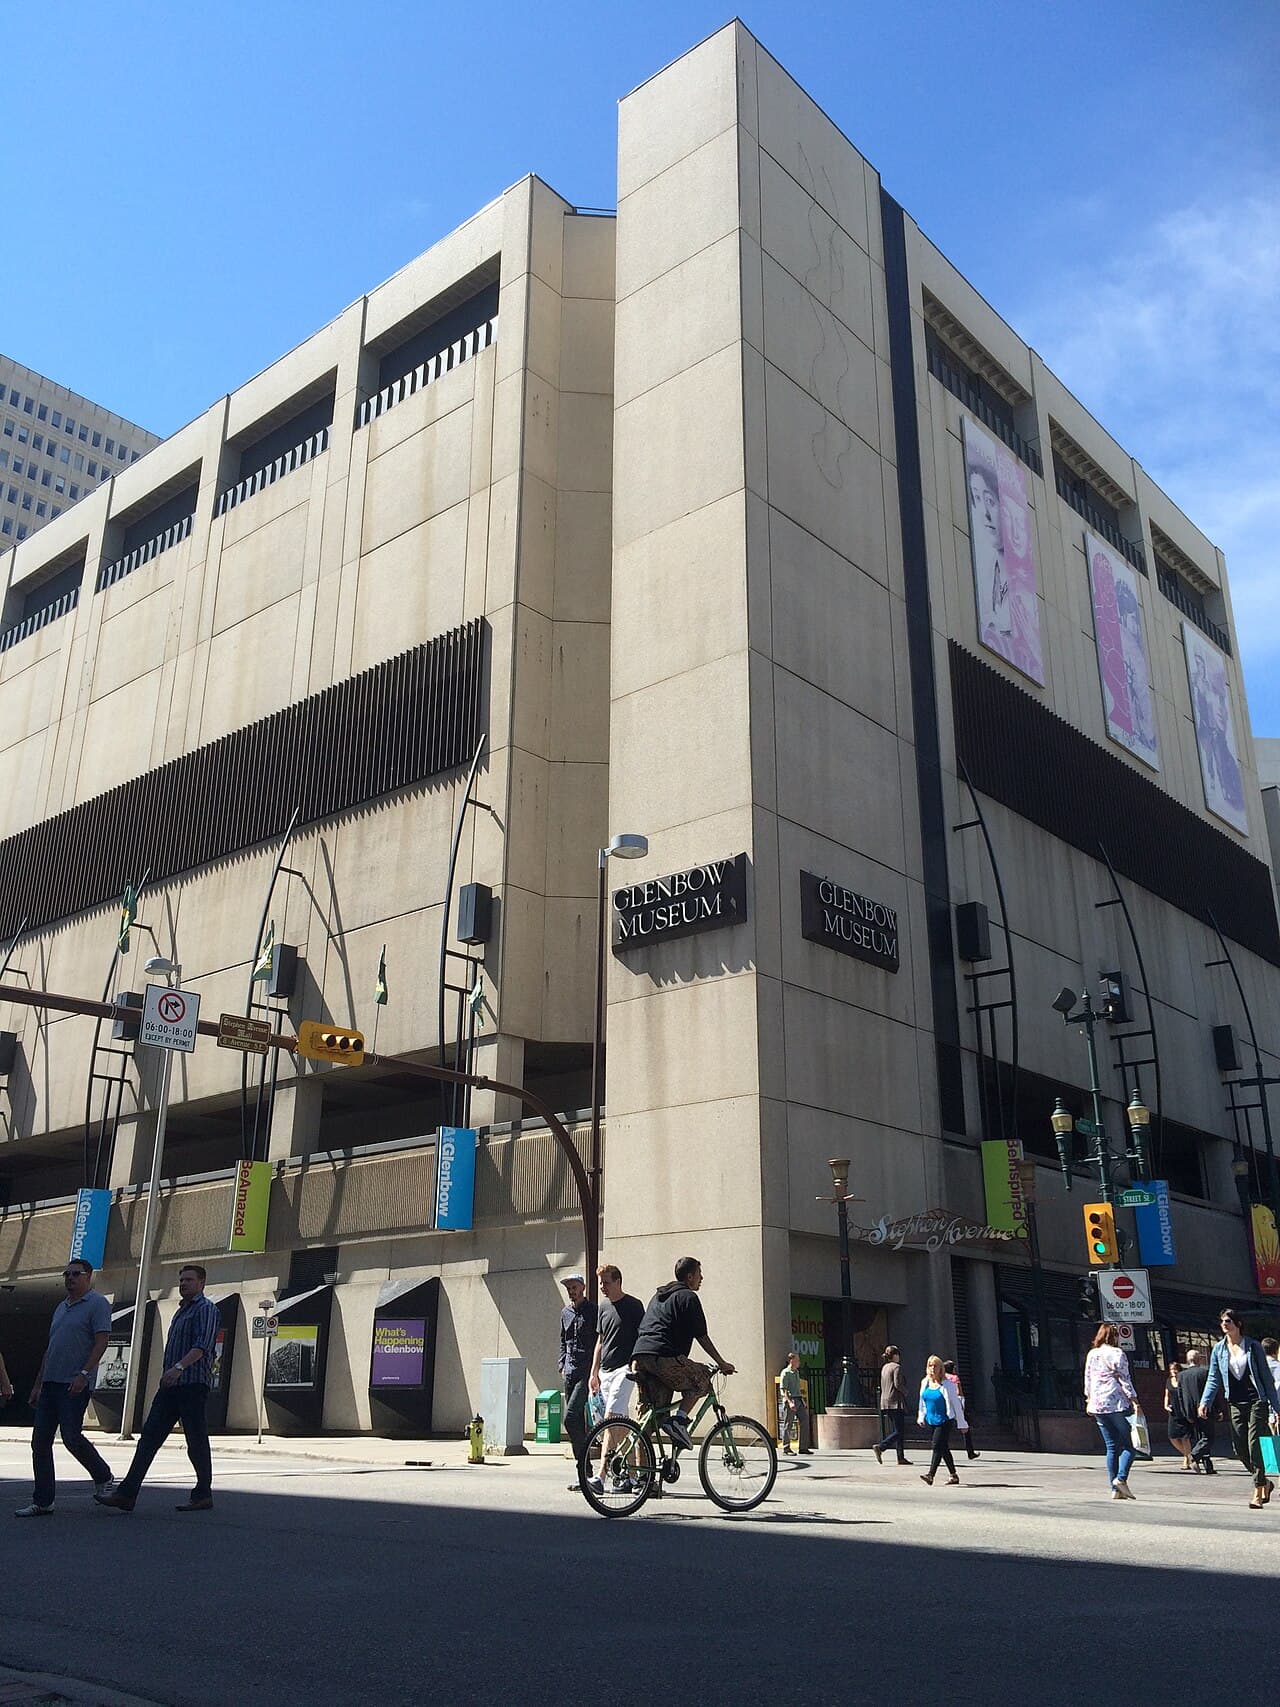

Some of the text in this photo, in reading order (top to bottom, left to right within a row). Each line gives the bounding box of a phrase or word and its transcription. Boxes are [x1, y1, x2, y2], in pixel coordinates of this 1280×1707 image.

[613, 861, 727, 911] GLENBOW
[618, 891, 722, 940] MUSEUM
[819, 881, 896, 931] GLENBOW
[824, 909, 897, 959] MUSEUM
[145, 1022, 193, 1038] 06:00-18:00
[145, 1033, 164, 1042] EXCEPT
[235, 1160, 253, 1236] BeAmazed
[374, 1335, 425, 1347] Happening
[375, 1328, 407, 1337] What's
[374, 1345, 425, 1354] AtGlenbow
